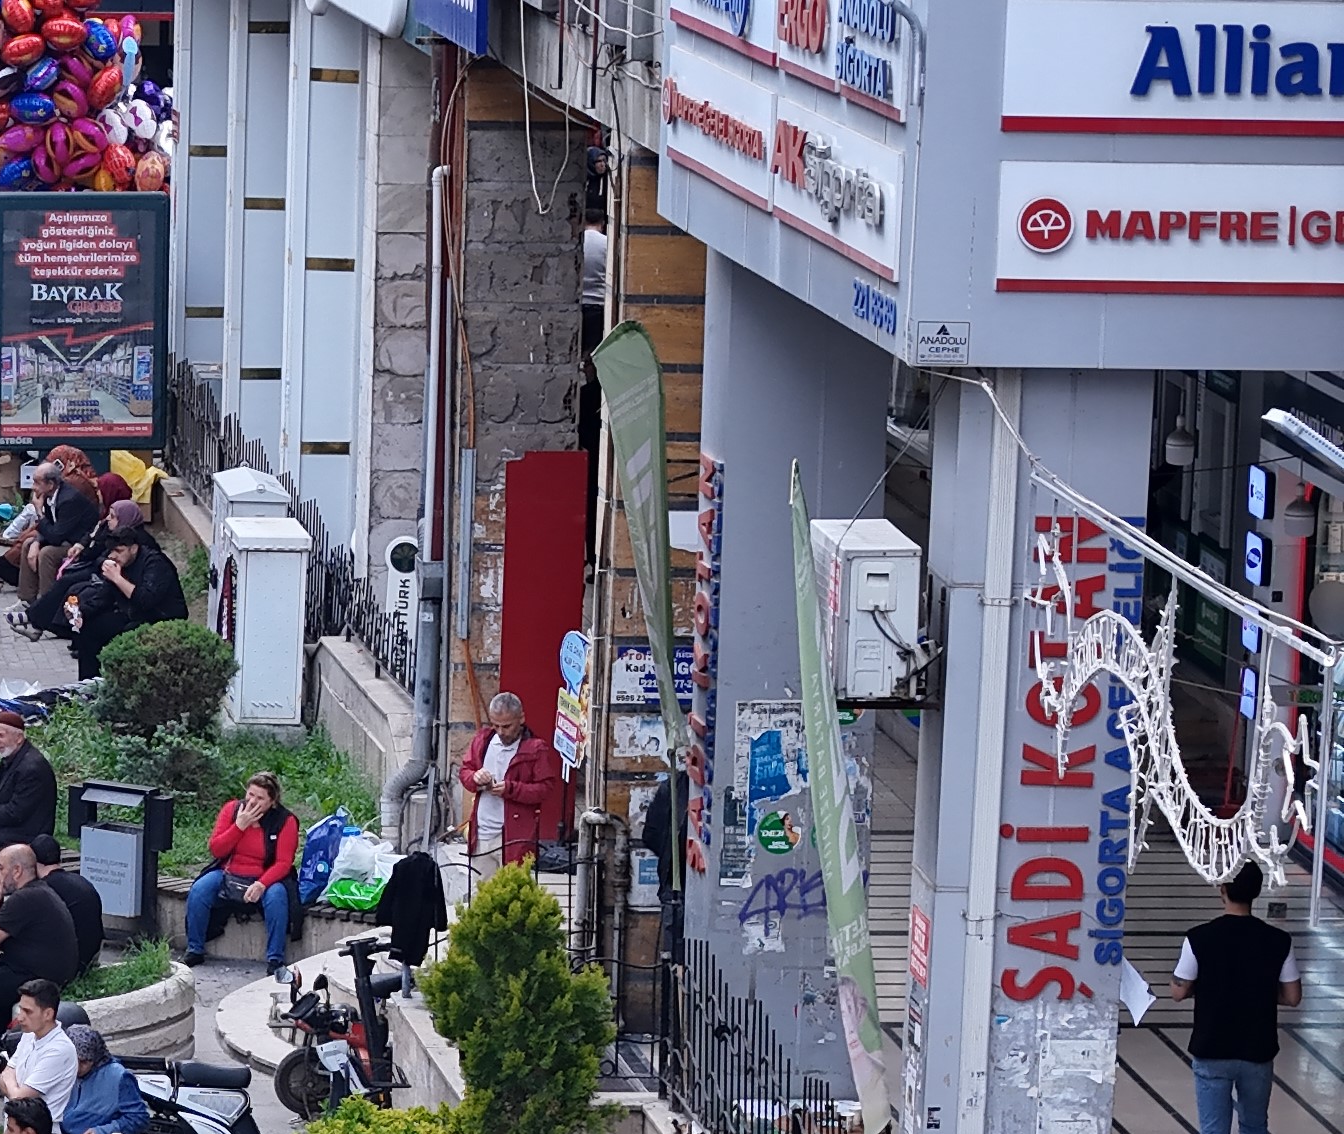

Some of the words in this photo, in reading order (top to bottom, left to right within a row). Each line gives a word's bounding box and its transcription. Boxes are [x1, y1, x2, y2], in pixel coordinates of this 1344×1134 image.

[778, 0, 827, 54] ERGO
[838, 0, 896, 43] ANADOLU
[48, 213, 108, 225] Açılışımıza
[1086, 210, 1279, 243] MAPFRE
[41, 225, 115, 238] gösterdiğiniz
[22, 240, 57, 252] yoğun
[59, 240, 97, 252] ilgiden
[98, 239, 133, 252] dolayı
[18, 253, 41, 263] tüm
[43, 253, 137, 265] hemşehrilerimize
[33, 266, 82, 278] teşekkür
[30, 282, 124, 304] BAYRAK
[919, 336, 967, 345] ANADOLU
[1020, 515, 1109, 788] KOTAN
[1088, 786, 1131, 966] SİGORTA
[1000, 822, 1095, 1002] ŞADİ
